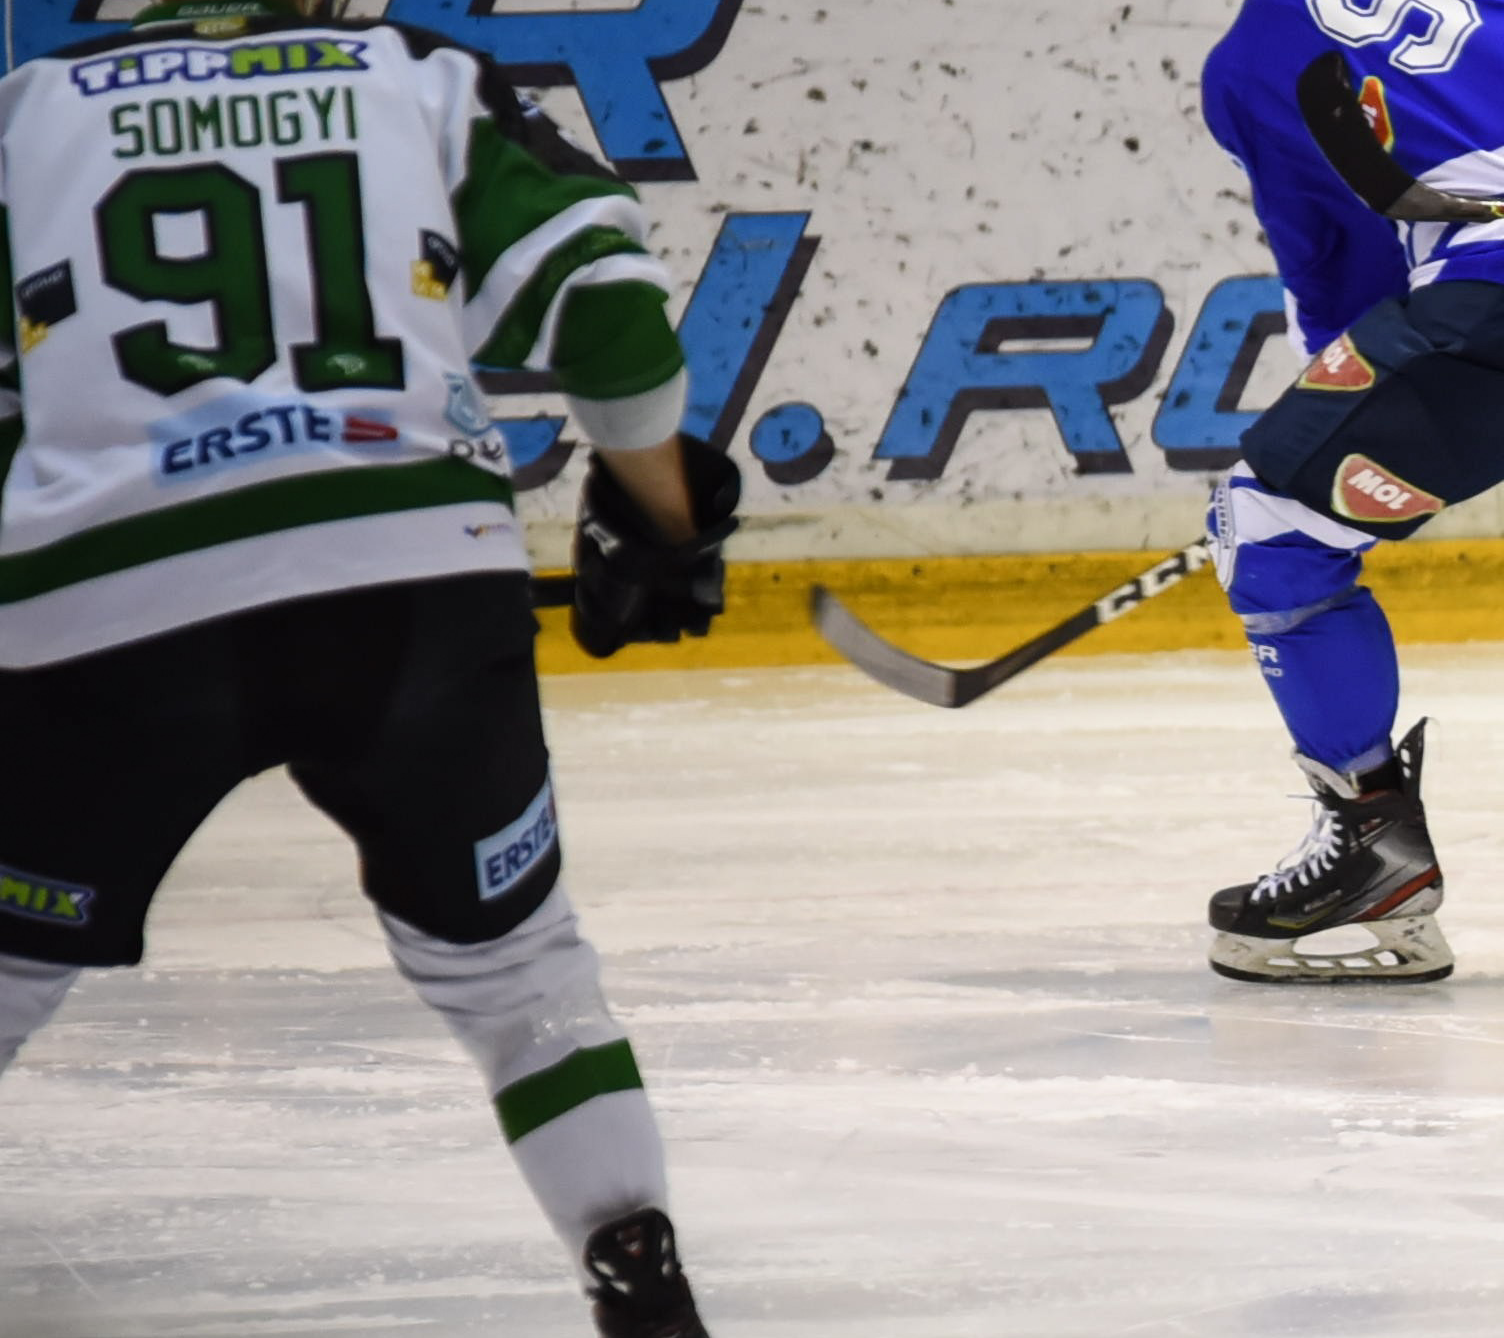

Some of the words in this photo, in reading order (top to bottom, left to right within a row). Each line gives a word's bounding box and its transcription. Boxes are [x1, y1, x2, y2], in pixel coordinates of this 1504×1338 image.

[110, 86, 358, 160] SOMOGYI
[94, 151, 406, 397] 91
[161, 404, 333, 475] ERSTE
[1346, 468, 1412, 512] MOL
[484, 811, 556, 891] ERSTE
